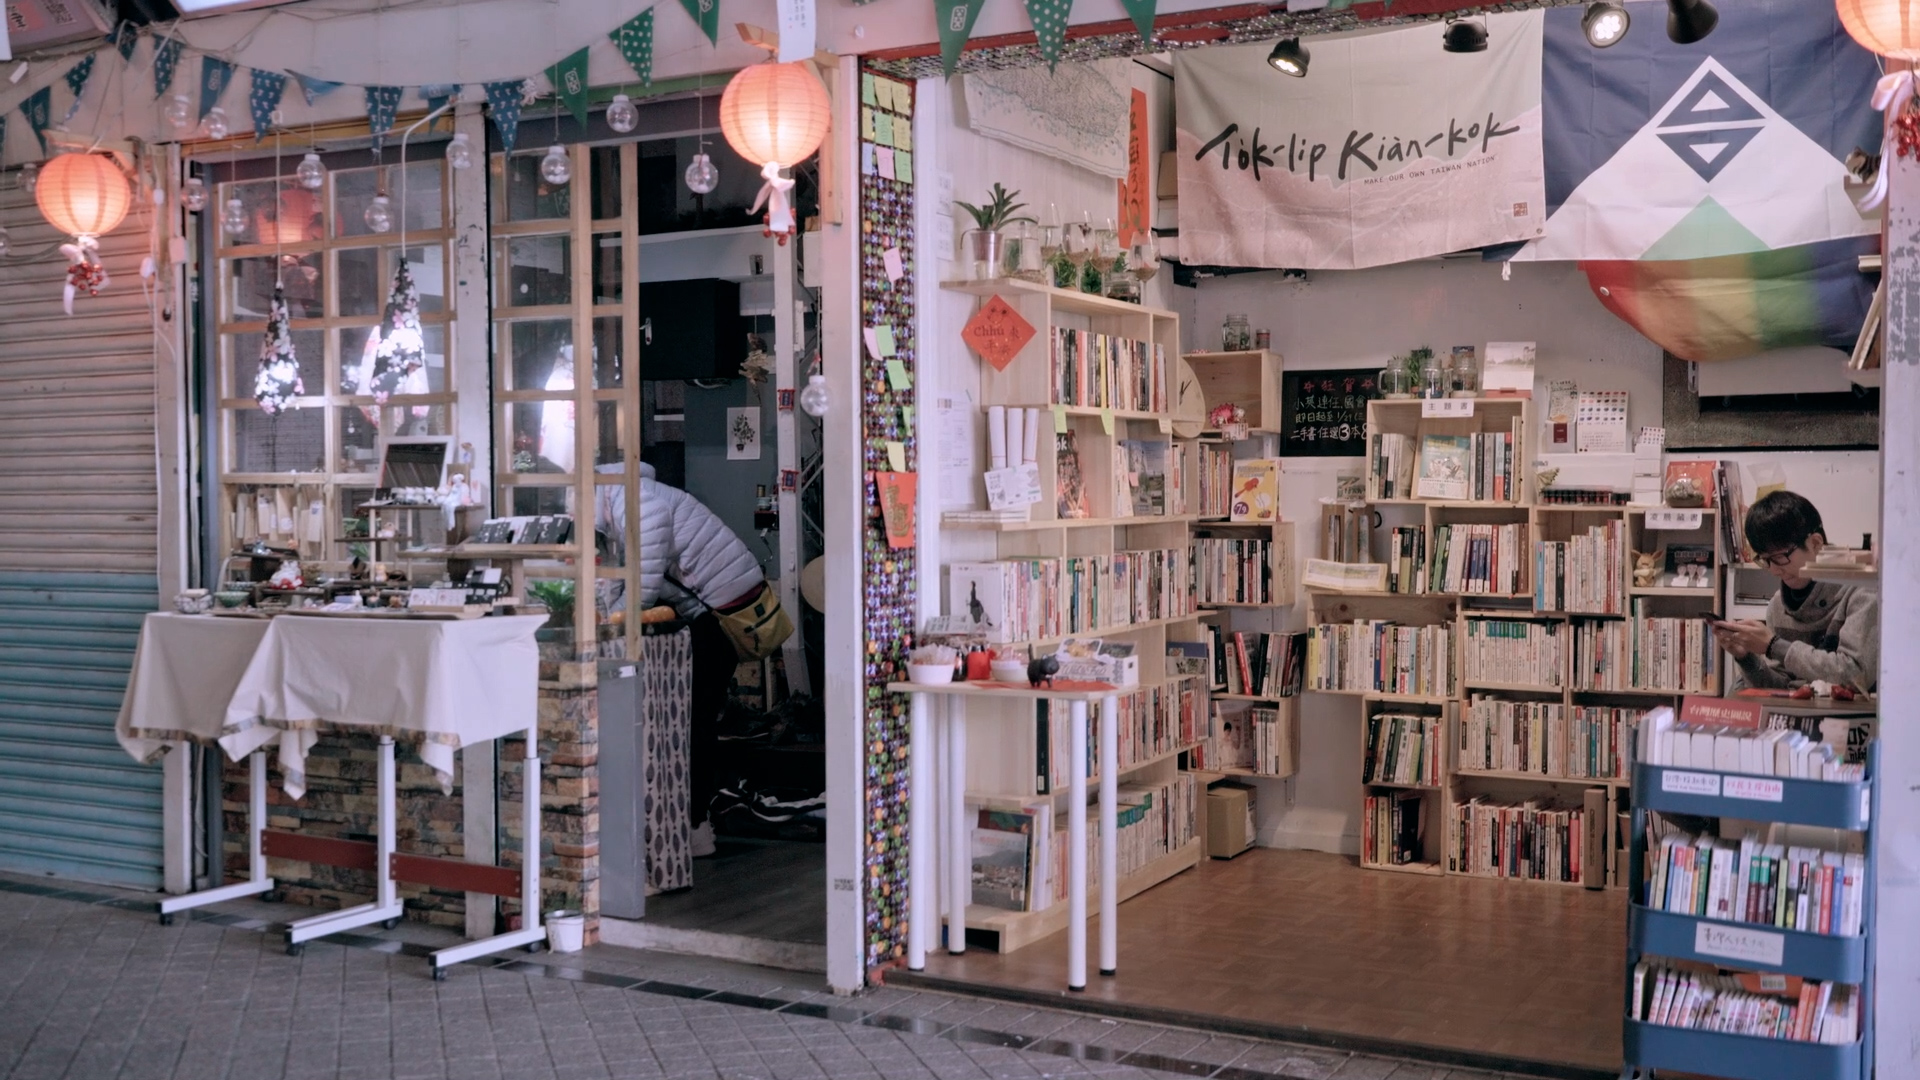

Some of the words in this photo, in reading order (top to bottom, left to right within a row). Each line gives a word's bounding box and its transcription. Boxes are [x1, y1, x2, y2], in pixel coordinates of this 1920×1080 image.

[1338, 112, 1520, 180] Kiàn-kok
[1364, 178, 1384, 186] MAKE
[1389, 174, 1404, 182] OUR
[1409, 171, 1425, 179] OWN
[1431, 164, 1462, 175] TAIWAN
[1466, 155, 1496, 168] NATION
[1321, 377, 1356, 393] 狂賀
[1295, 394, 1370, 411] 小英連任、國會
